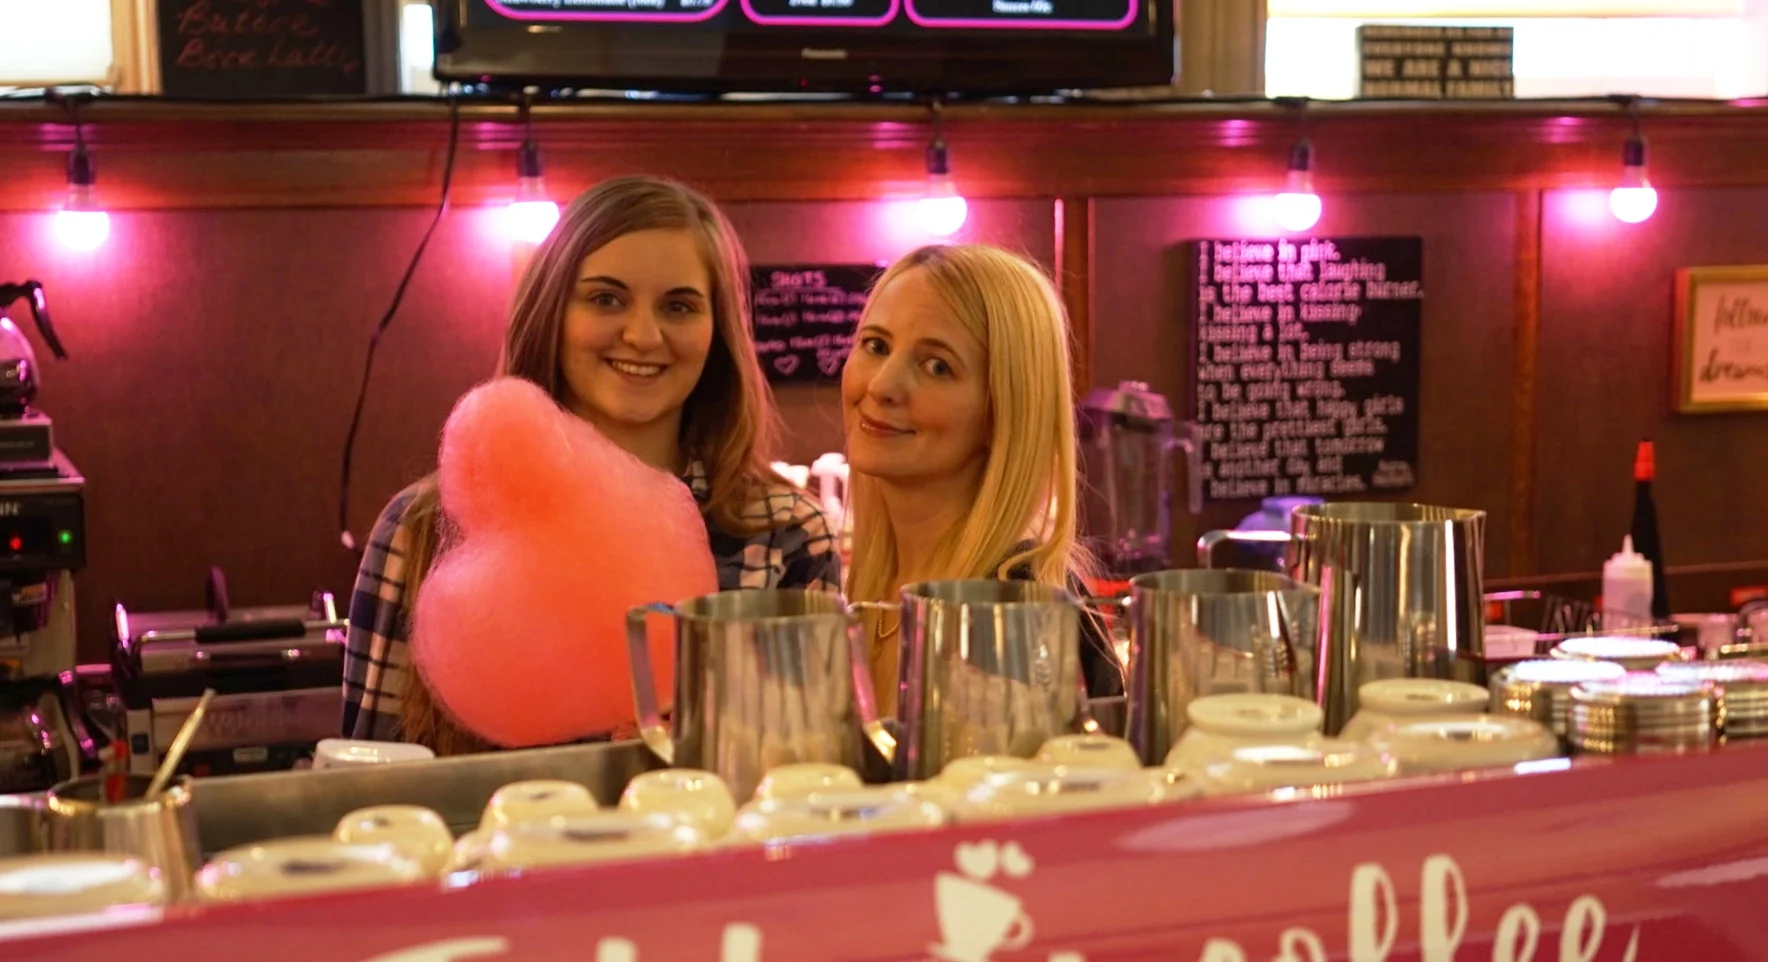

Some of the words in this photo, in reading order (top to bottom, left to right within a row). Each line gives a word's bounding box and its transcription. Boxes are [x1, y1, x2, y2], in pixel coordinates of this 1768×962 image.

[1402, 59, 1440, 76] ARE
[1447, 59, 1464, 76] A
[1213, 240, 1274, 263] believe
[1278, 238, 1297, 263] in
[1213, 261, 1274, 283] believe
[1278, 262, 1313, 282] that
[1319, 259, 1387, 282] laughing
[1222, 282, 1253, 302] the
[1257, 282, 1295, 302] best
[1300, 281, 1362, 301] calorie
[1213, 303, 1273, 323] believe
[1278, 302, 1295, 323] in
[1713, 293, 1768, 336] follo
[1262, 323, 1274, 342] a
[1213, 343, 1273, 364] believe
[1278, 342, 1295, 363] in
[1300, 338, 1343, 361] being
[1348, 340, 1400, 362] strong
[1198, 362, 1236, 381] when
[1240, 360, 1326, 384] everything
[1700, 346, 1768, 383] dream
[1198, 382, 1218, 401] to
[1221, 382, 1242, 401] be
[1246, 380, 1291, 402] going
[1211, 400, 1271, 421] believe
[1275, 399, 1310, 420] that
[1316, 399, 1358, 420] happy
[1229, 421, 1258, 441] the
[1274, 438, 1309, 458] that
[1315, 436, 1385, 454] tomorrow
[1218, 457, 1280, 479] another
[1316, 455, 1343, 474] and
[1200, 855, 1640, 962] ffee
